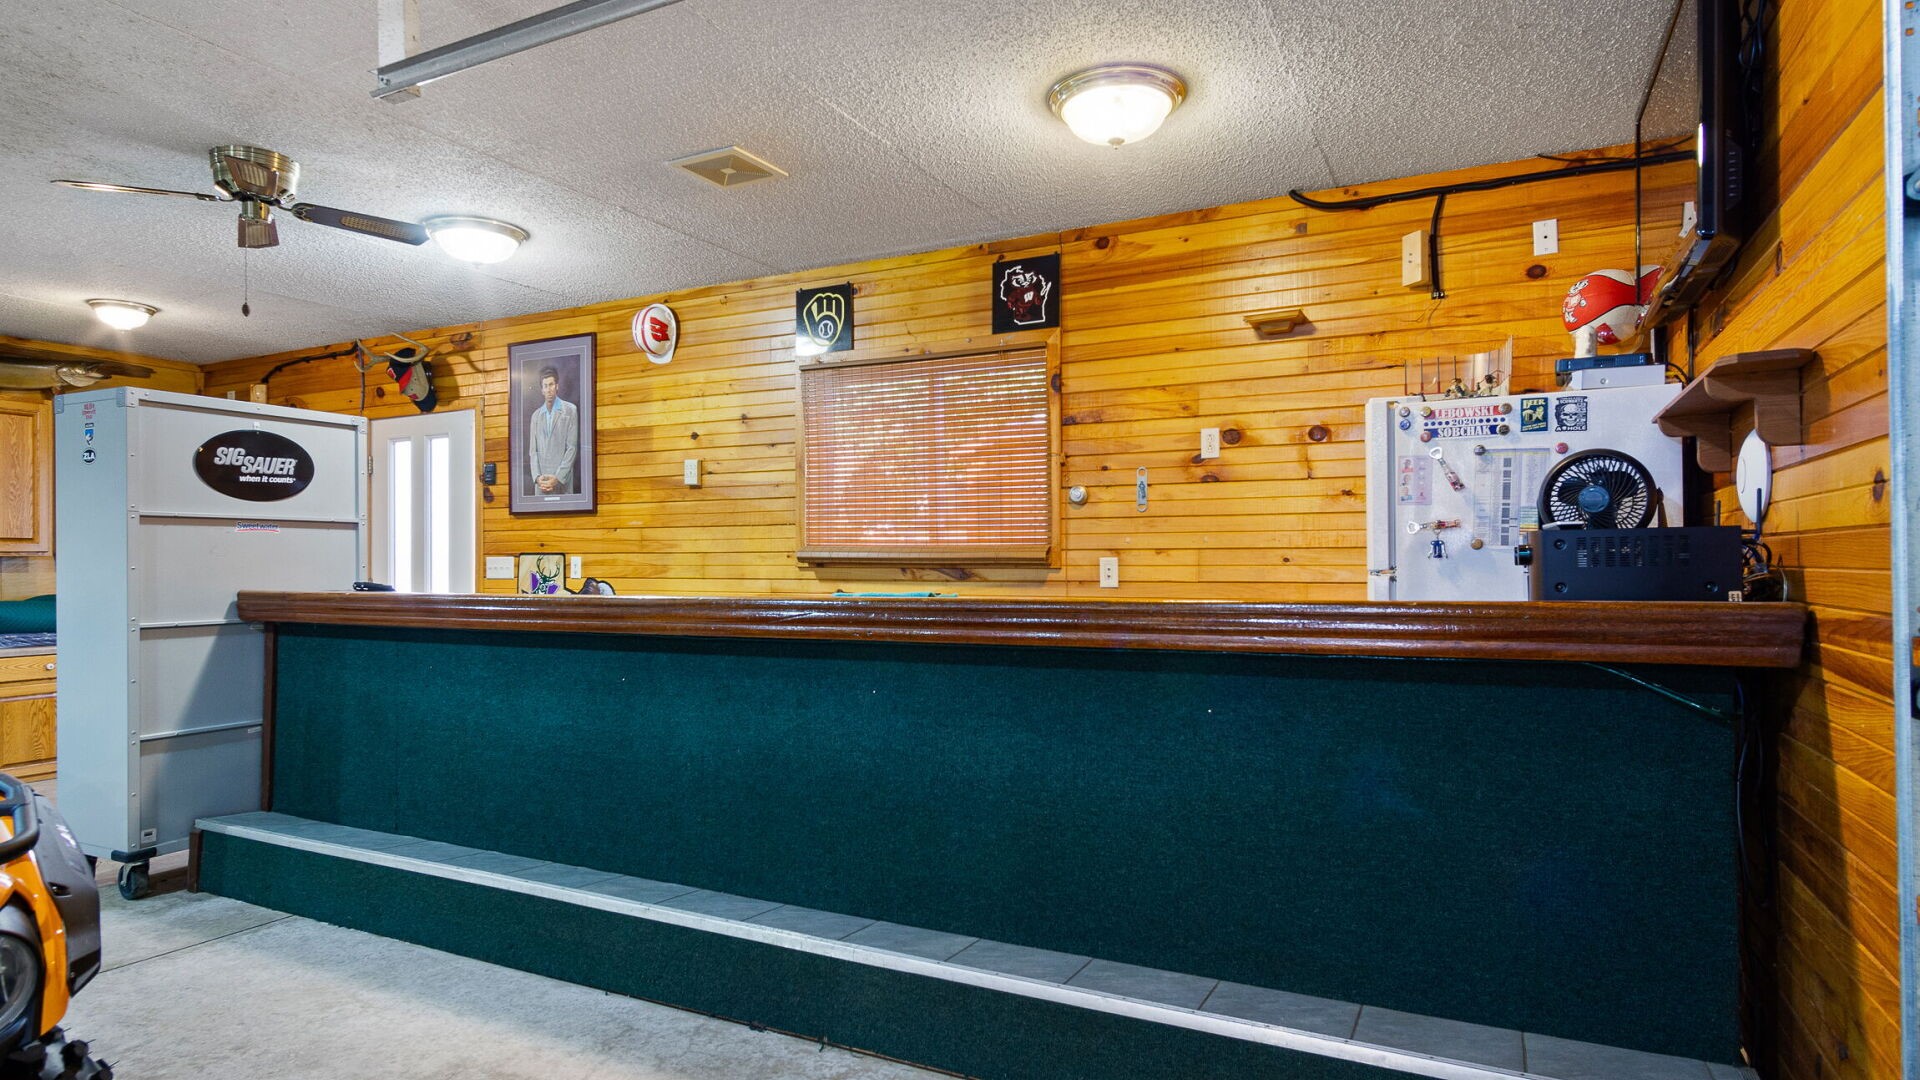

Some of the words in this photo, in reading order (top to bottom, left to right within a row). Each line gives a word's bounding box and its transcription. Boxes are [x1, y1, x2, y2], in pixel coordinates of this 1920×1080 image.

[1522, 399, 1546, 409] BEER
[1435, 405, 1494, 418] LEBOWSKI
[1452, 418, 1477, 426] 2020
[1438, 425, 1491, 438] SOBCHAK
[213, 446, 246, 466] SIG
[240, 456, 297, 475] SAUER
[239, 474, 261, 483] when
[261, 475, 269, 483] it
[268, 476, 294, 484] counts
